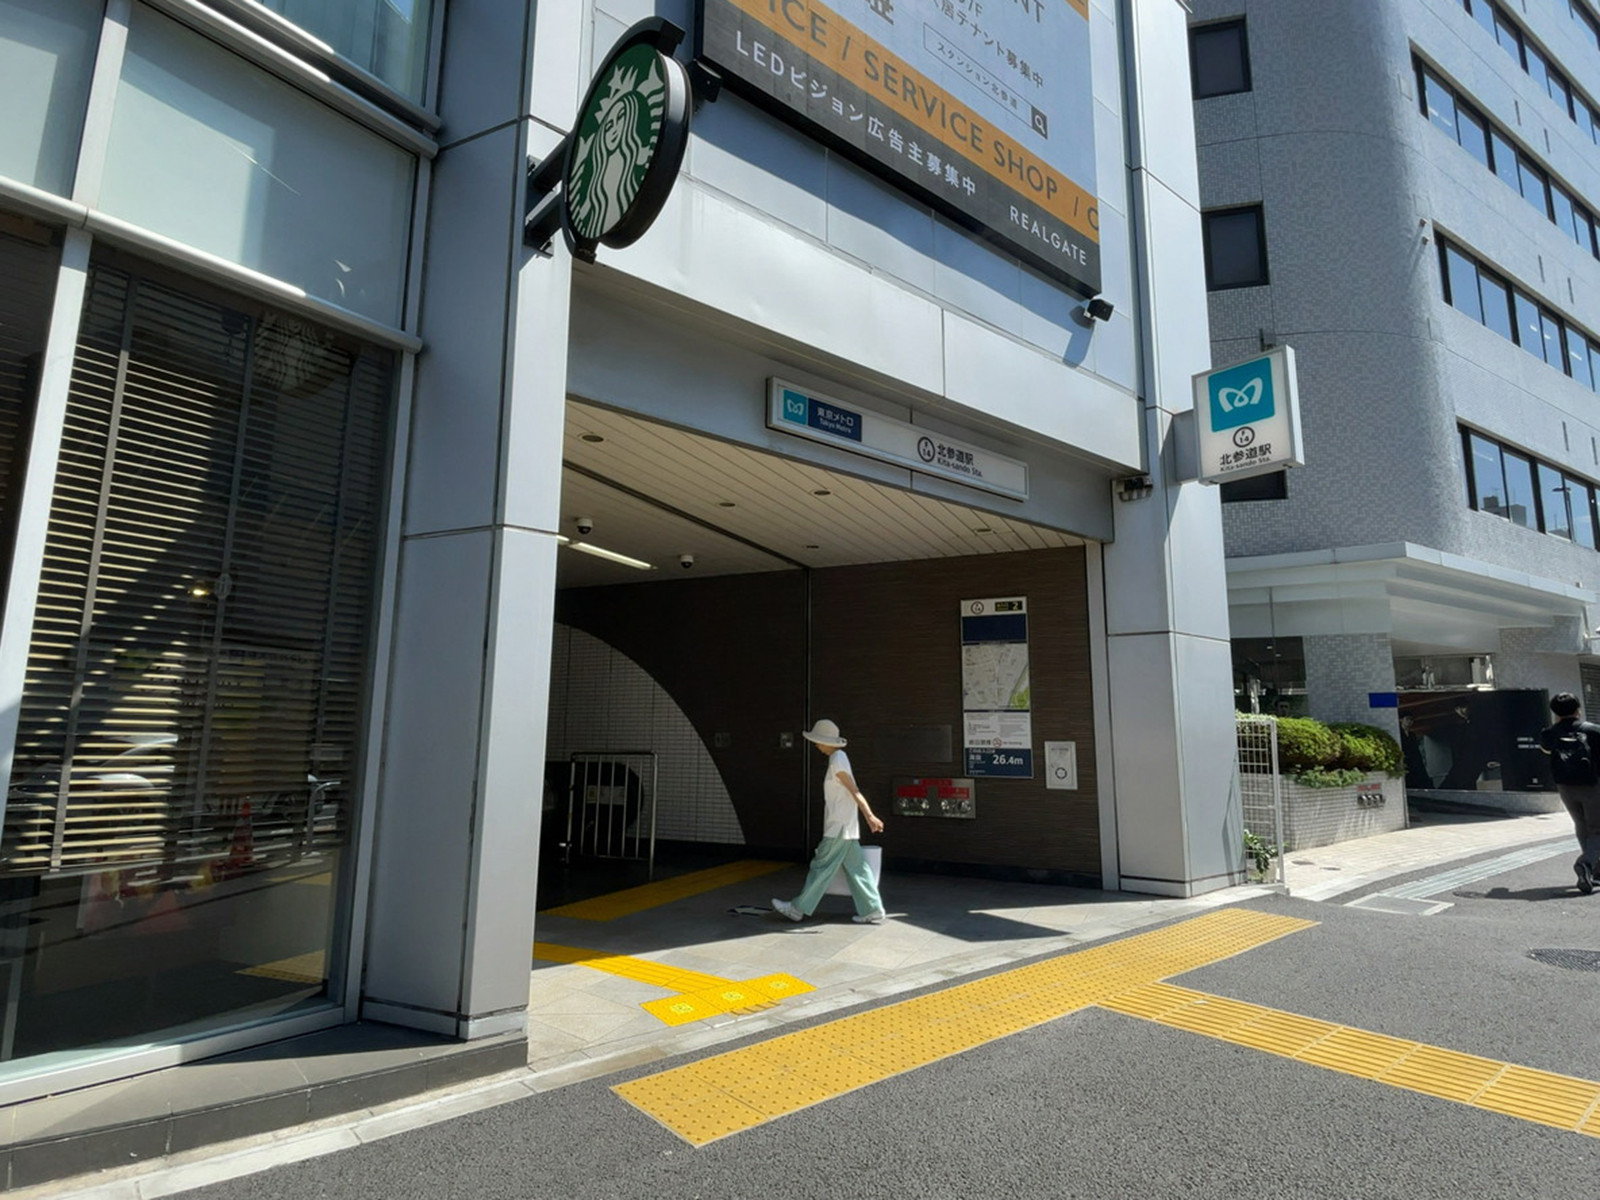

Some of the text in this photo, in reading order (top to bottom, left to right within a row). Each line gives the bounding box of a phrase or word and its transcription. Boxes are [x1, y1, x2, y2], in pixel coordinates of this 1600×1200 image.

[736, 29, 977, 198] LEDビジョン広告主募集中
[864, 50, 983, 153] SERVICE
[993, 139, 1058, 200] SHOP
[1009, 205, 1087, 266] REALGATE
[817, 406, 854, 427] 東京メトロ
[937, 443, 974, 466] 北参道駅
[1219, 443, 1272, 466] 北参道駅
[1012, 601, 1019, 611] 2
[992, 754, 1024, 765] 26.4m
